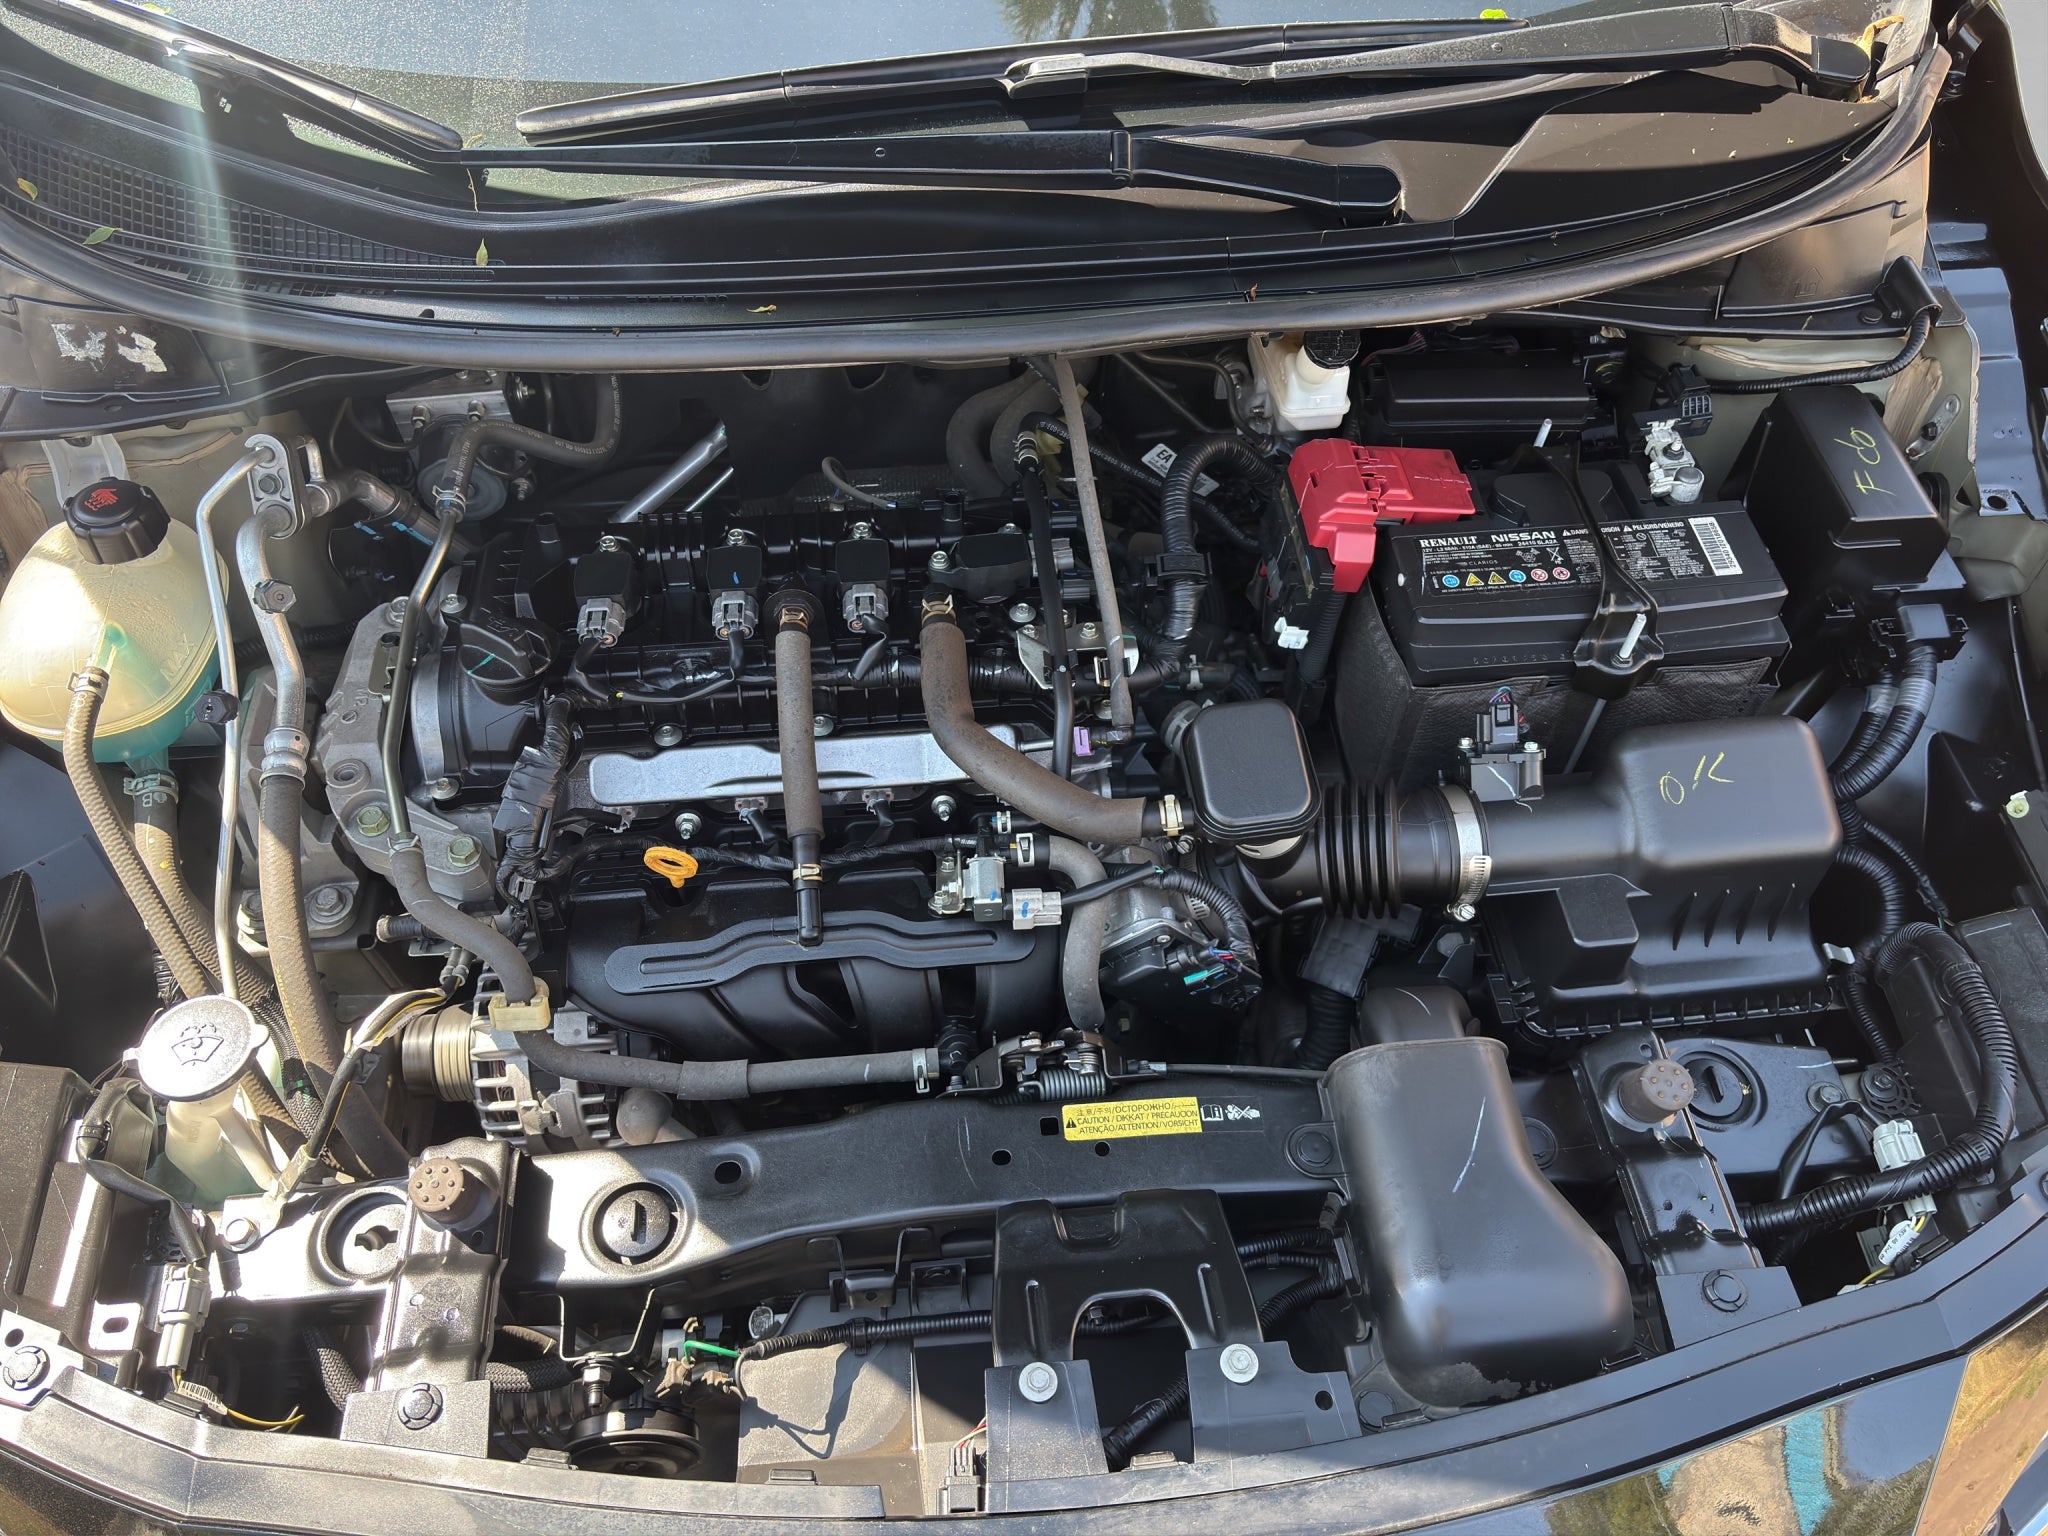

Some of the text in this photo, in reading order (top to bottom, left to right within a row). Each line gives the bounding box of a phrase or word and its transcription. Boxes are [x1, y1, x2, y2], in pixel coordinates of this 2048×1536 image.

[1156, 449, 1174, 464] EA
[1419, 530, 1557, 547] RENAULT NISSAN
[1660, 751, 1735, 805] OK
[1077, 1115, 1110, 1125] CAUTION
[1116, 1113, 1145, 1122] DIKKAT
